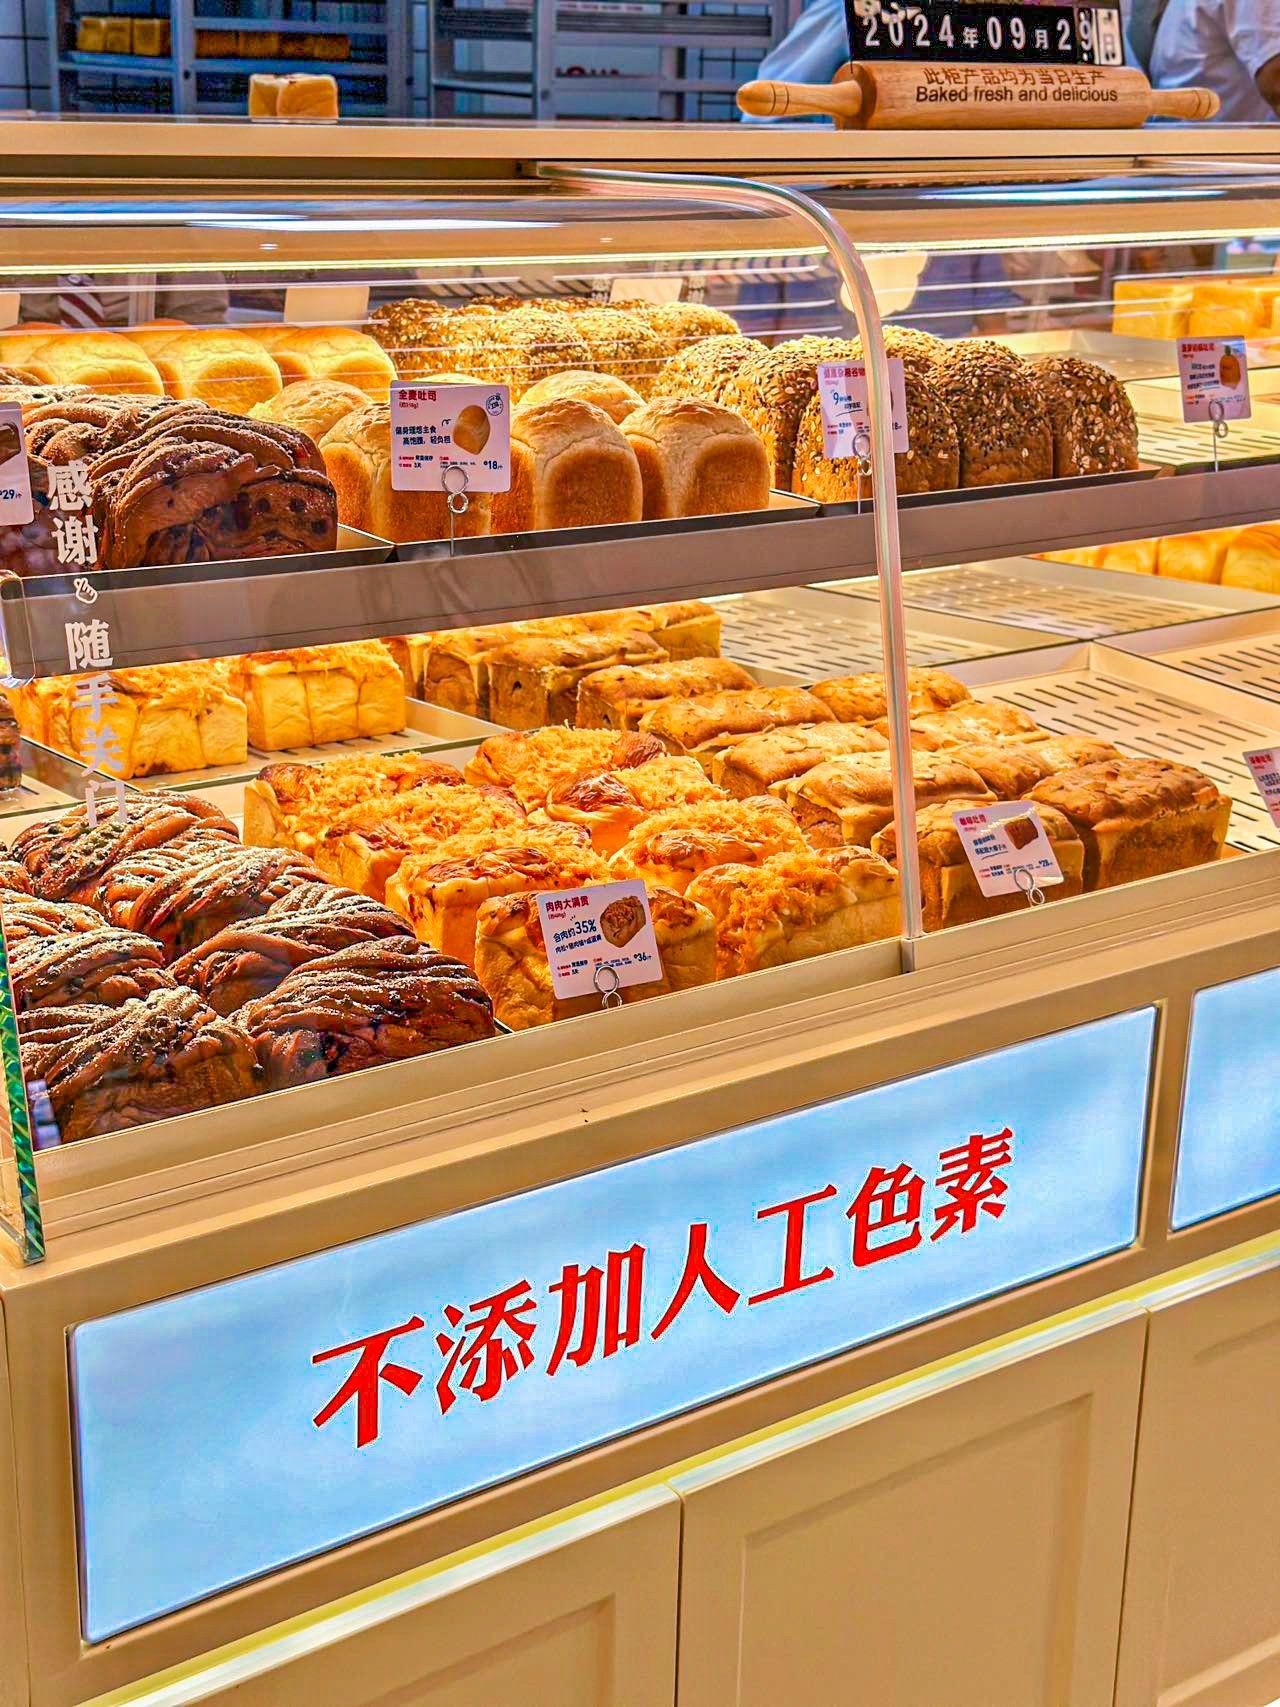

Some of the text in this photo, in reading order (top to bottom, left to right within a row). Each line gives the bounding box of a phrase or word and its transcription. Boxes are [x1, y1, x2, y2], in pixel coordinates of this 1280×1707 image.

[923, 68, 1105, 86] 此柜产品均为当日生产
[916, 85, 1118, 102] Baked fresh and delicious
[398, 390, 437, 401] 全麦吐司
[47, 460, 128, 829] 感谢 随手关门
[545, 895, 590, 912] 肉肉大满贯
[553, 919, 597, 943] 含肉约35%
[312, 1126, 1014, 1449] 不添加人工色素
